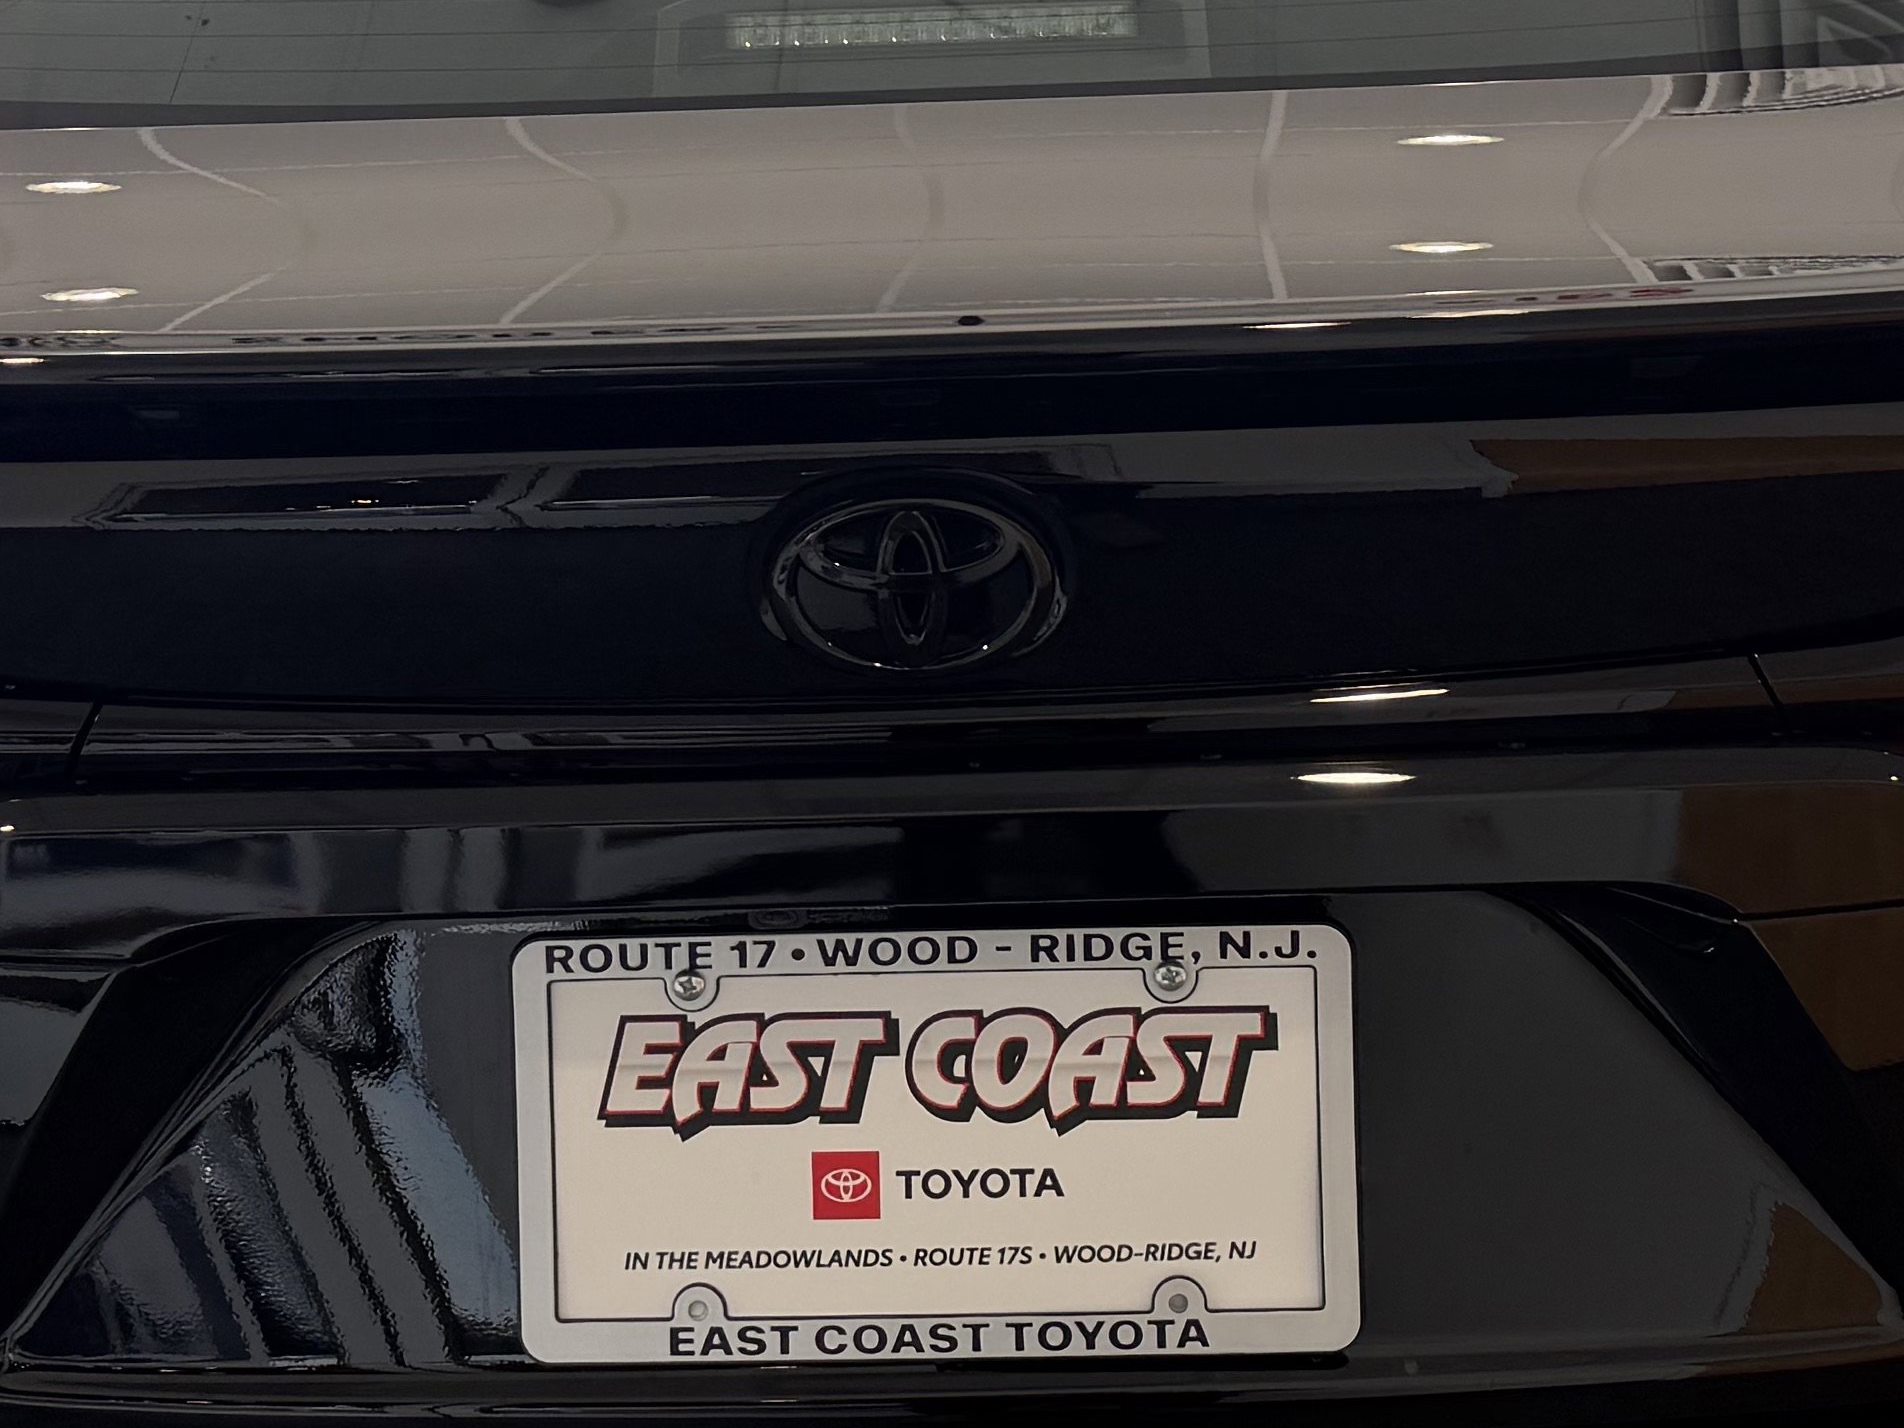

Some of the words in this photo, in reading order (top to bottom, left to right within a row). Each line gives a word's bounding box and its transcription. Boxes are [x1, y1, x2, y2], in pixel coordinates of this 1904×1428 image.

[544, 941, 713, 974] ROUTE
[729, 938, 777, 969] 17
[816, 935, 979, 968] WOOD
[1029, 931, 1204, 967] RIDGE,
[1218, 929, 1318, 961] N.J.
[598, 1008, 900, 1143] EAST
[904, 1004, 1279, 1139] COAST
[896, 1167, 1066, 1201] TOYOTA
[624, 1252, 652, 1272] IN
[655, 1251, 698, 1272] THE
[704, 1249, 894, 1271] MEADOWLANDS
[913, 1247, 993, 1268] ROUTE
[997, 1246, 1033, 1268] 17S
[1054, 1243, 1222, 1268] WOOD-RIDGE,
[1228, 1242, 1258, 1262] NJ
[669, 1326, 799, 1357] EAST
[815, 1323, 989, 1355] COAST
[1005, 1318, 1211, 1352] TOYOTA
